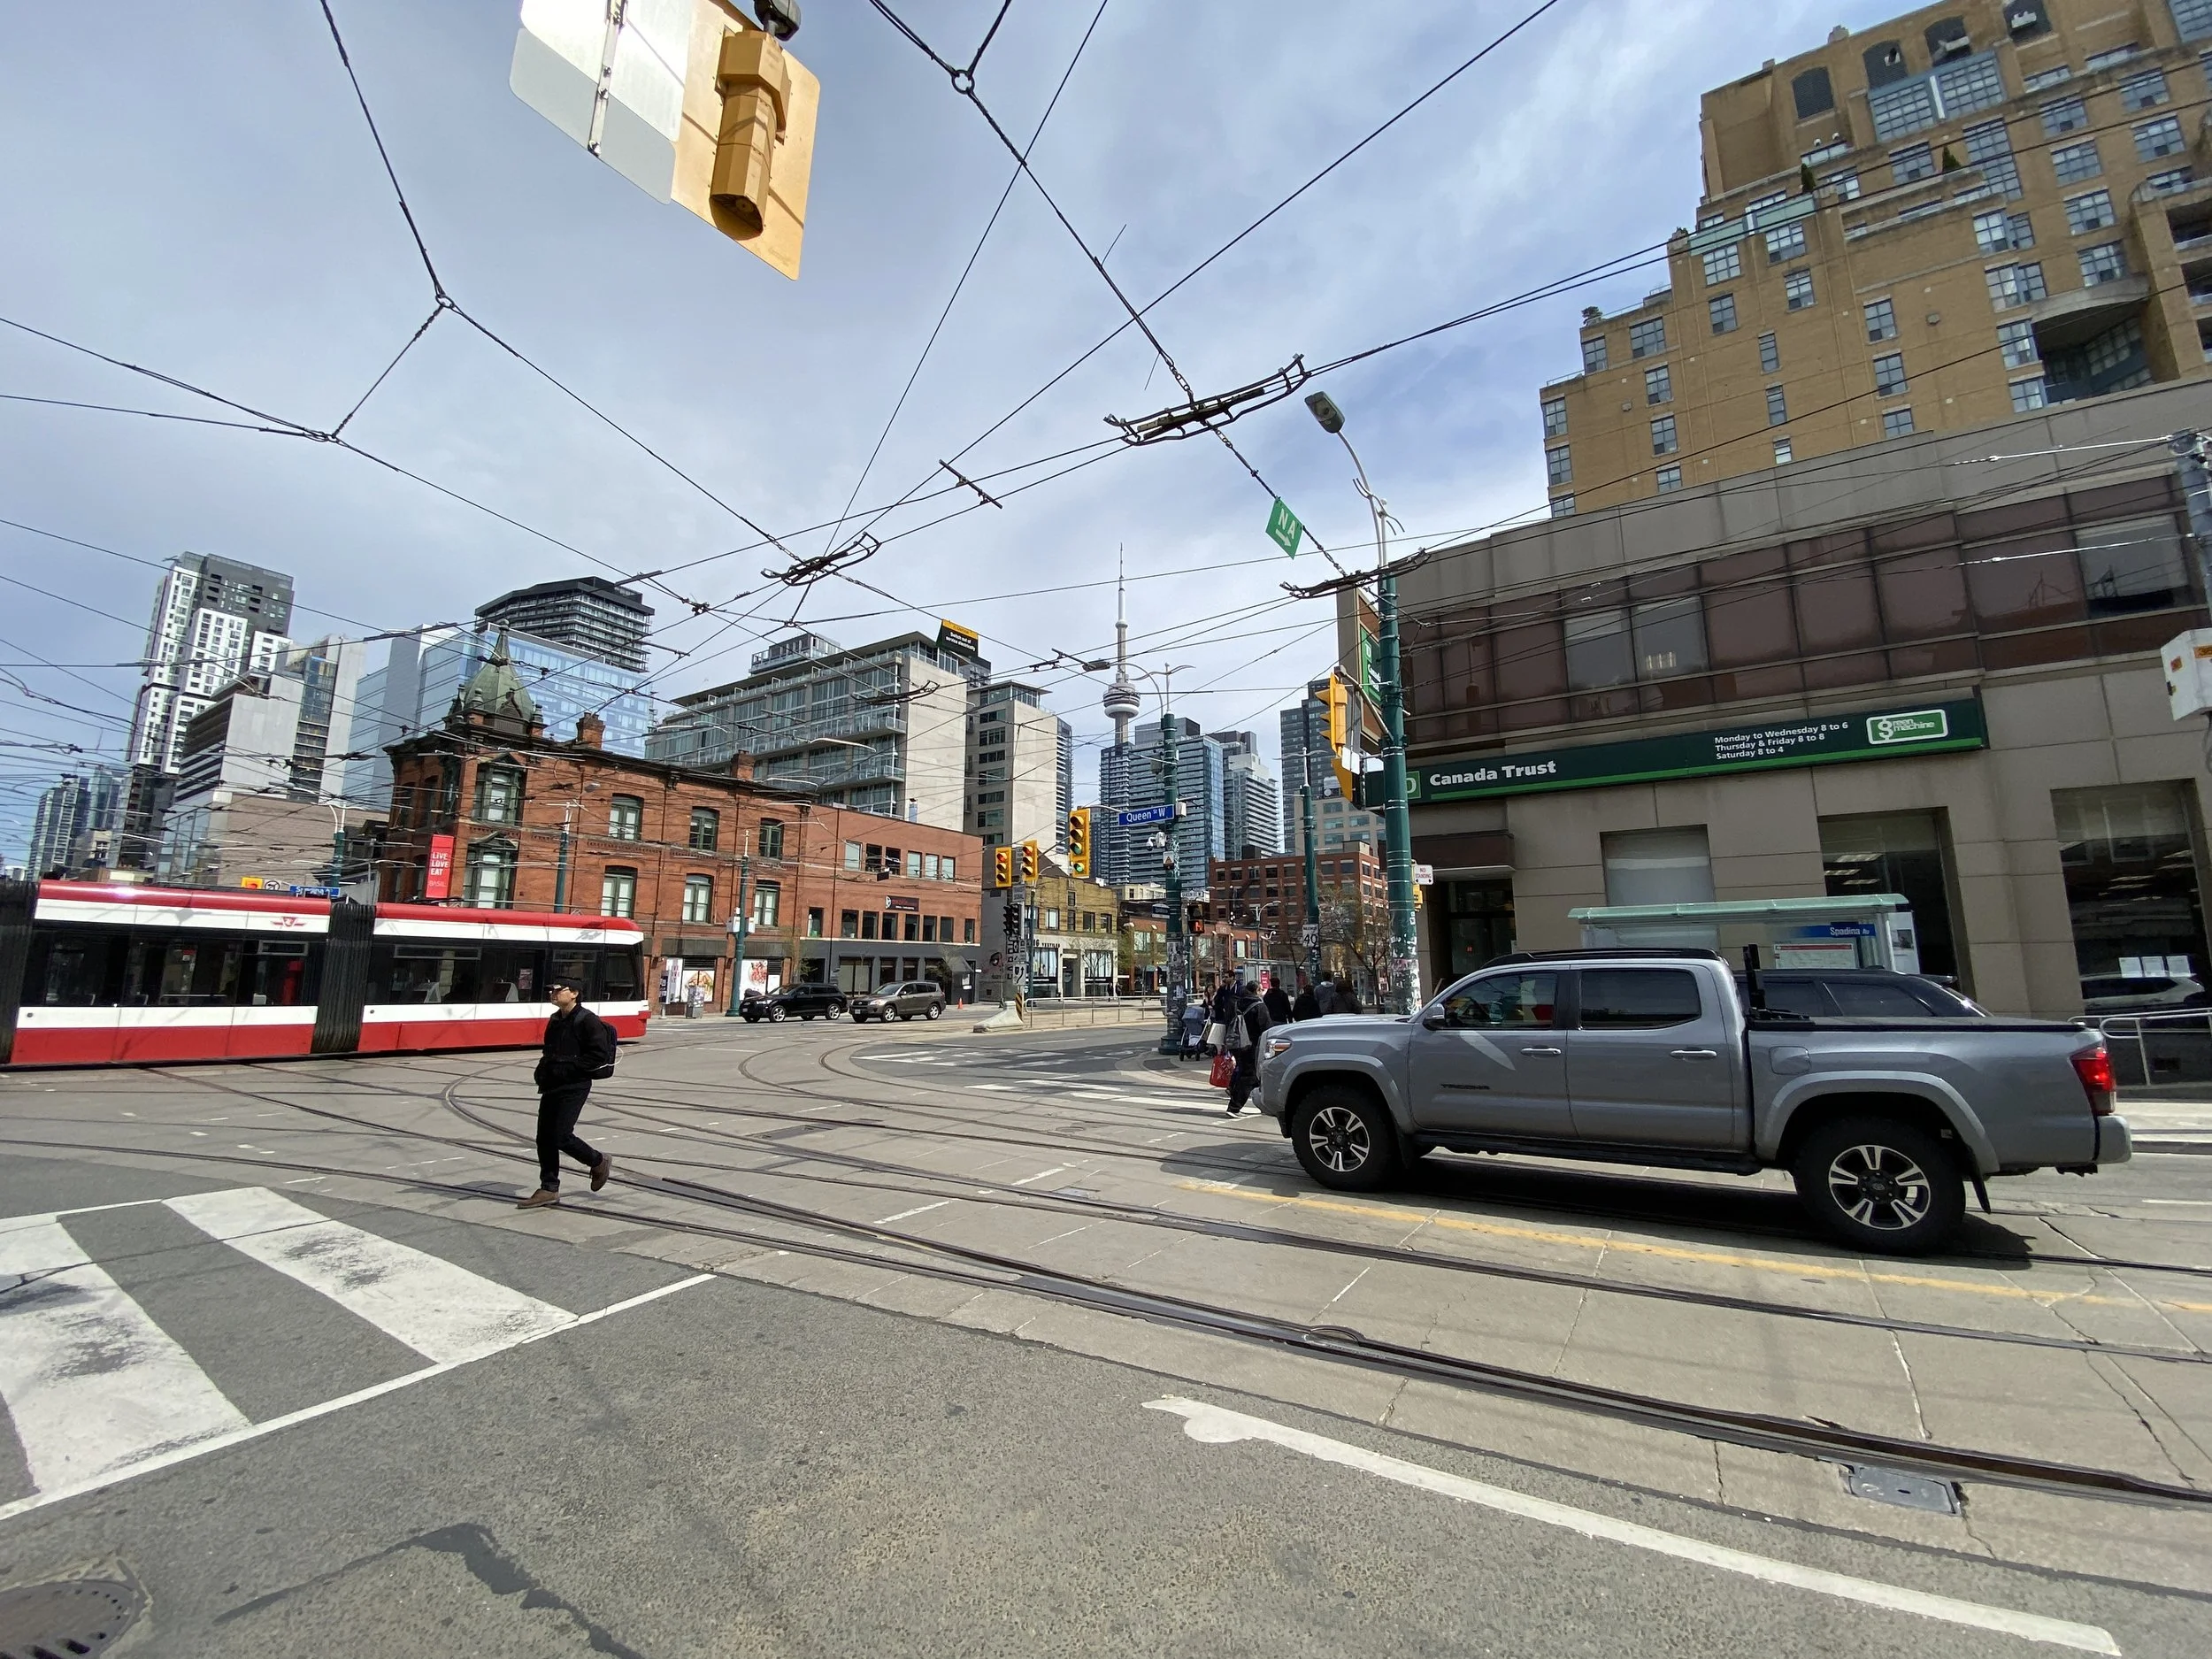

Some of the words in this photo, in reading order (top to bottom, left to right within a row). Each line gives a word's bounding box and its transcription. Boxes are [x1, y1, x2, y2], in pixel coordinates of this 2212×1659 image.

[1893, 722, 1935, 732] machine
[1715, 734, 1751, 744] Monday
[1764, 725, 1819, 738] Wednesday
[1715, 741, 1755, 752] Thursday
[1767, 736, 1796, 746] Friday
[1716, 750, 1755, 760] Saturday
[1429, 768, 1498, 787] Canada
[1502, 760, 1556, 779] Trust
[1126, 811, 1152, 823] Queen
[1158, 807, 1165, 817] W
[433, 851, 449, 860] LIVE
[430, 867, 443, 876] EAT
[1830, 926, 1860, 937] Spadina
